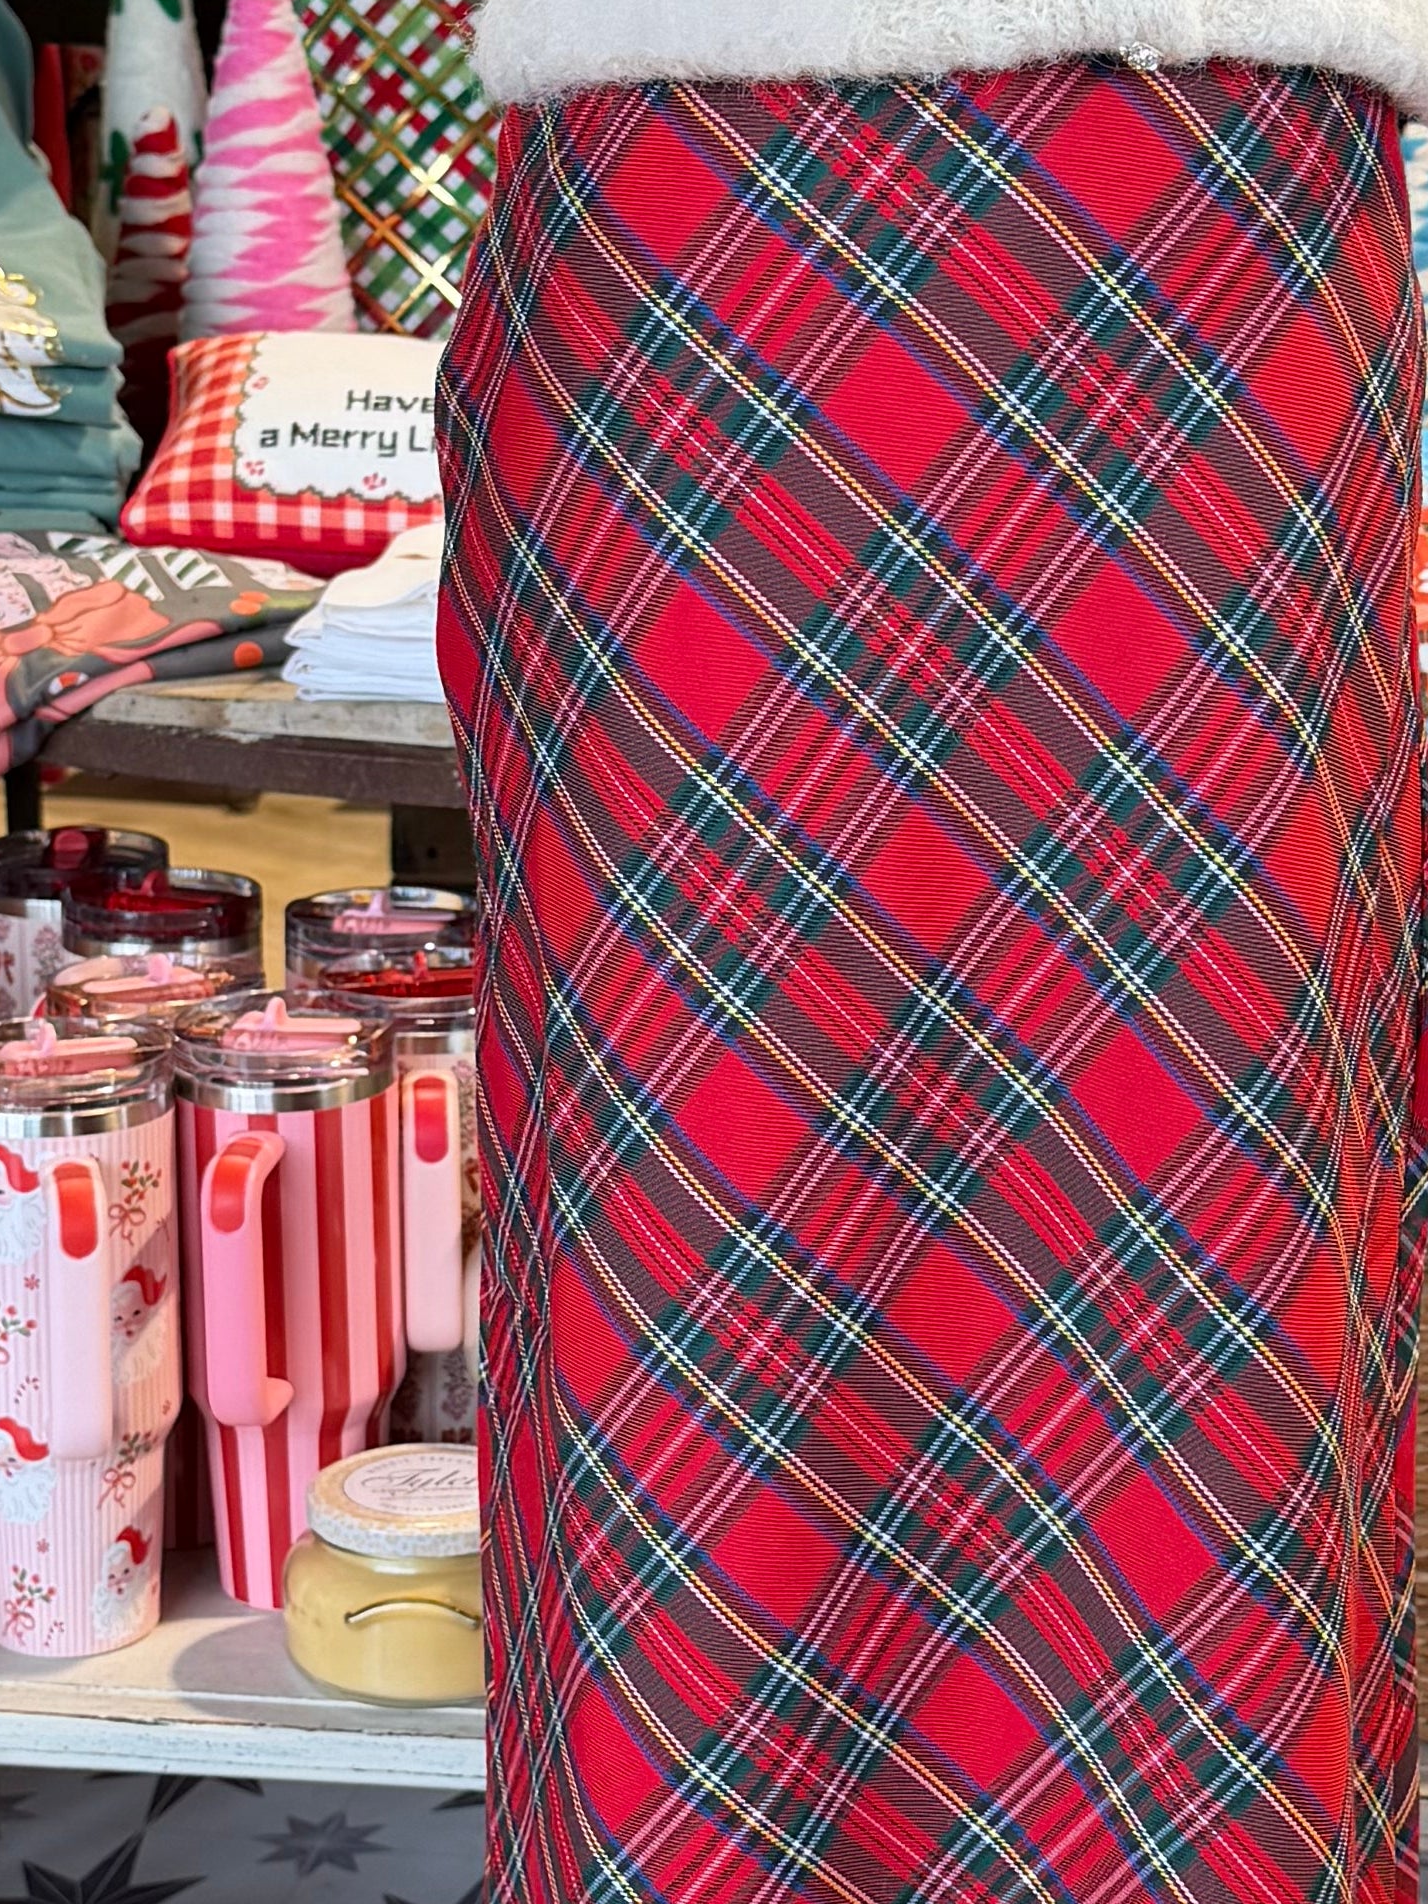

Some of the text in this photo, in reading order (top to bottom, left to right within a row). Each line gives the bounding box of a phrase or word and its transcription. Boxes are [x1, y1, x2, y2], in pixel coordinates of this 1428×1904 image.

[346, 388, 435, 414] Have
[259, 427, 280, 449] a
[290, 421, 399, 458] Merry
